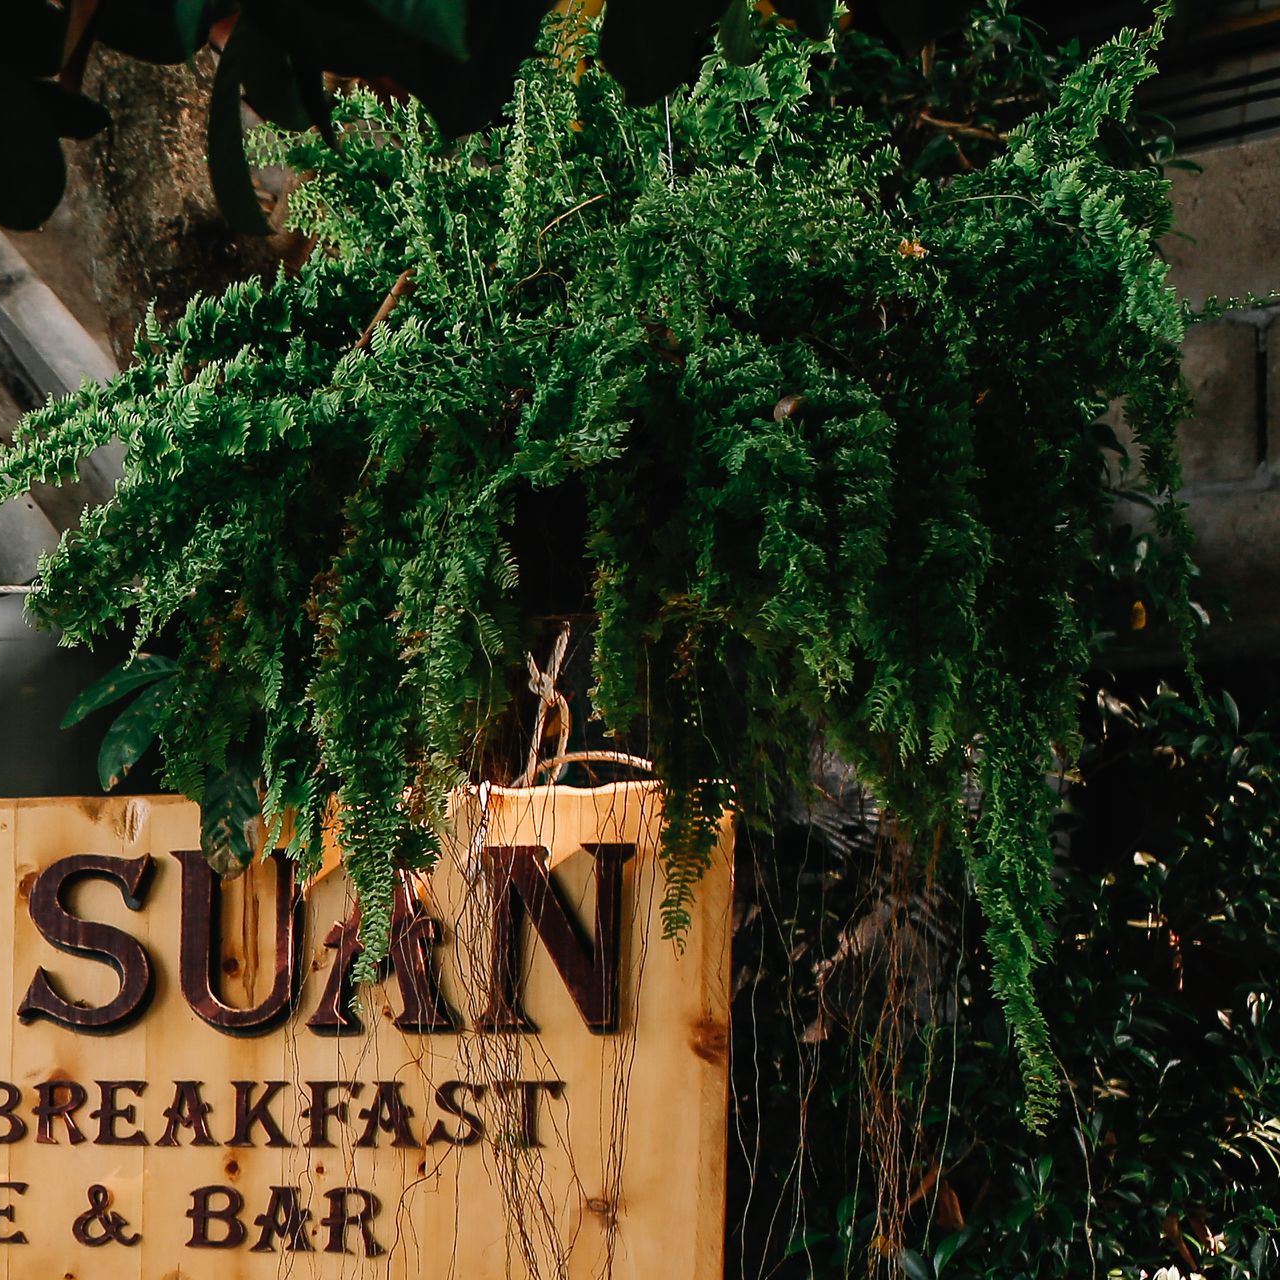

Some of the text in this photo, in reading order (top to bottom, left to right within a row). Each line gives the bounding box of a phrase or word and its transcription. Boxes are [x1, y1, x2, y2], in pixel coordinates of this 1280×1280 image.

[17, 843, 637, 1037] SUAN
[71, 1183, 142, 1248] &
[185, 1184, 387, 1259] BAR
